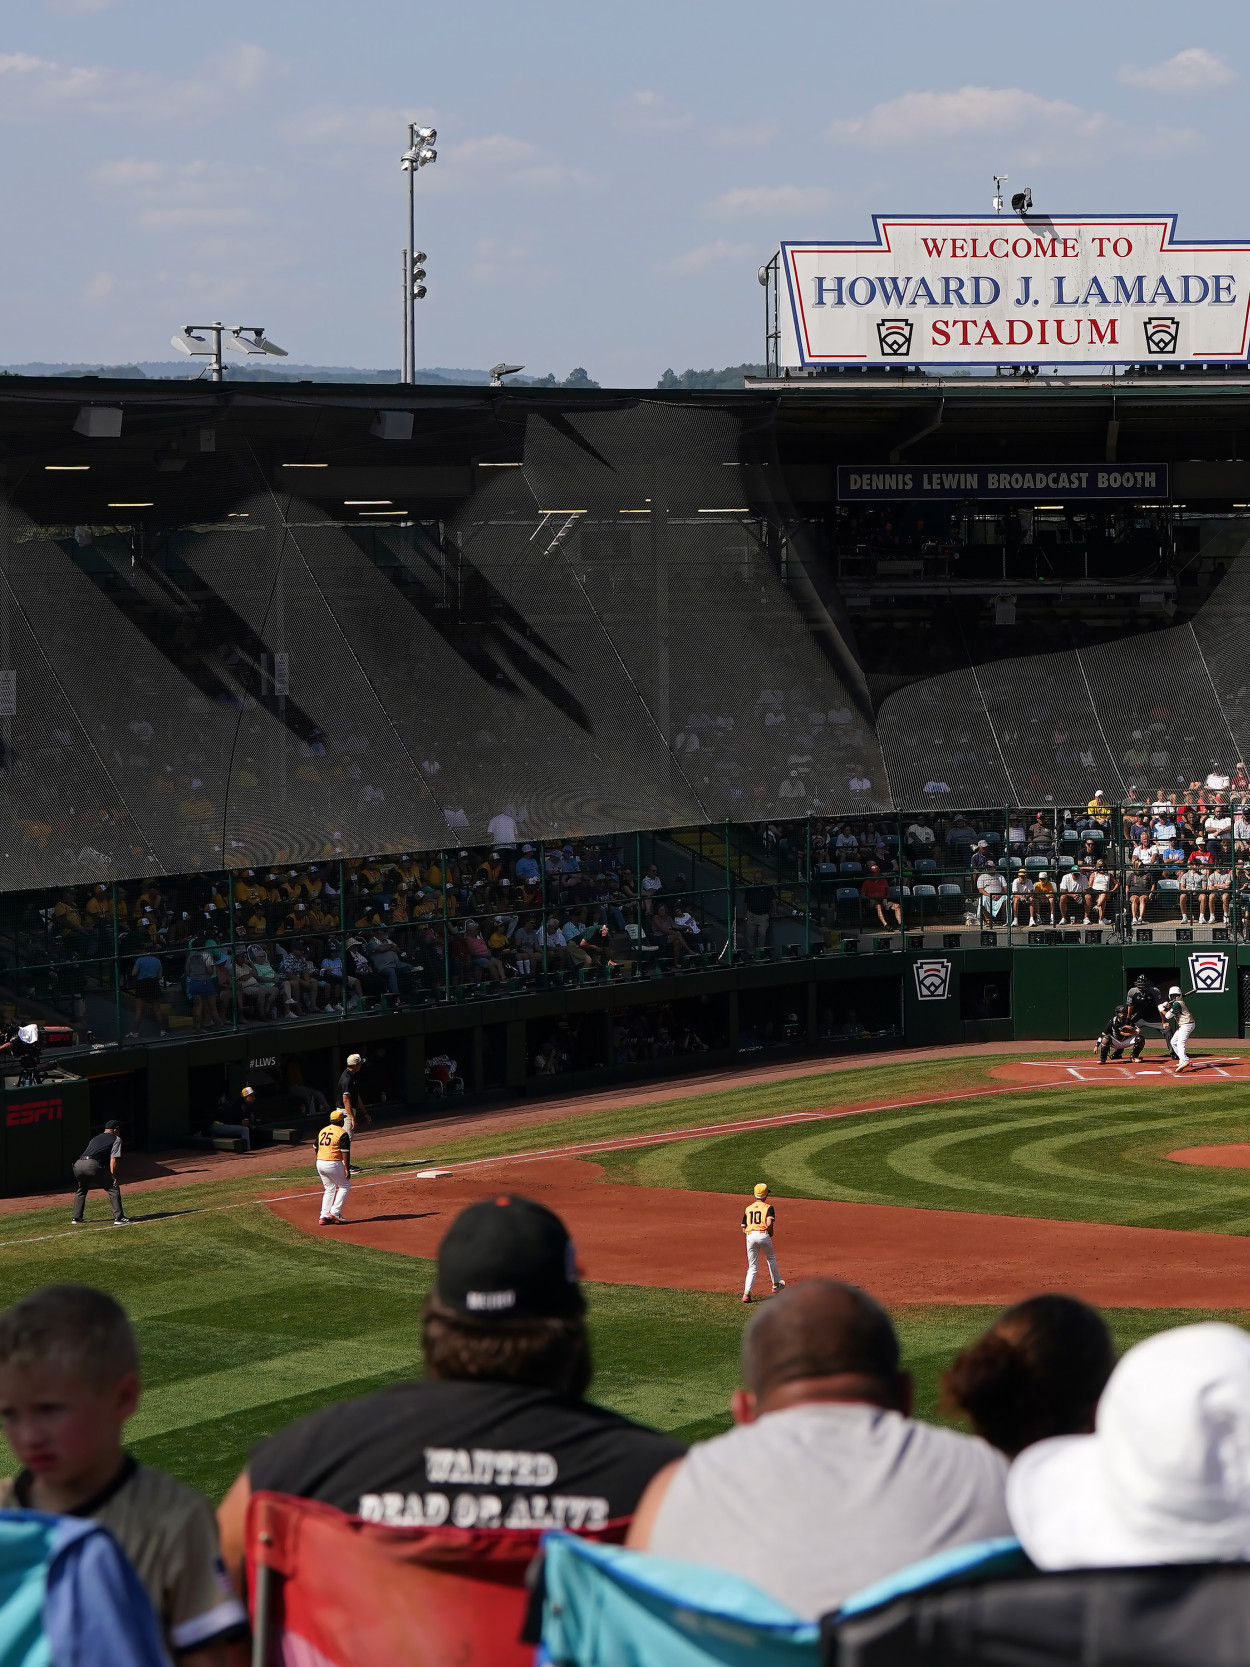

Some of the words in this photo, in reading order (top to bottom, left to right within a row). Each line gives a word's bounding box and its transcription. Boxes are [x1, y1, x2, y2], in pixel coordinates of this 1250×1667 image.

[922, 237, 1079, 258] WELCOME
[1091, 237, 1133, 257] TO
[812, 276, 1001, 309] HOWARD
[1014, 276, 1039, 308] J.
[1050, 275, 1236, 308] LAMADE
[932, 318, 1119, 346] STADIUM
[849, 473, 913, 490] DENNIS
[923, 473, 978, 490] LEWIN
[987, 472, 1089, 489] BROADCAST
[1098, 471, 1157, 488] BOOTH
[249, 1056, 276, 1069] #LLWS
[5, 1098, 63, 1127] ESPN
[320, 1132, 333, 1146] 25
[749, 1211, 762, 1224] 10
[424, 1448, 557, 1485] WANTED
[359, 1493, 449, 1526] DEAD
[453, 1494, 502, 1528] OR
[506, 1495, 609, 1529] ALIVE
